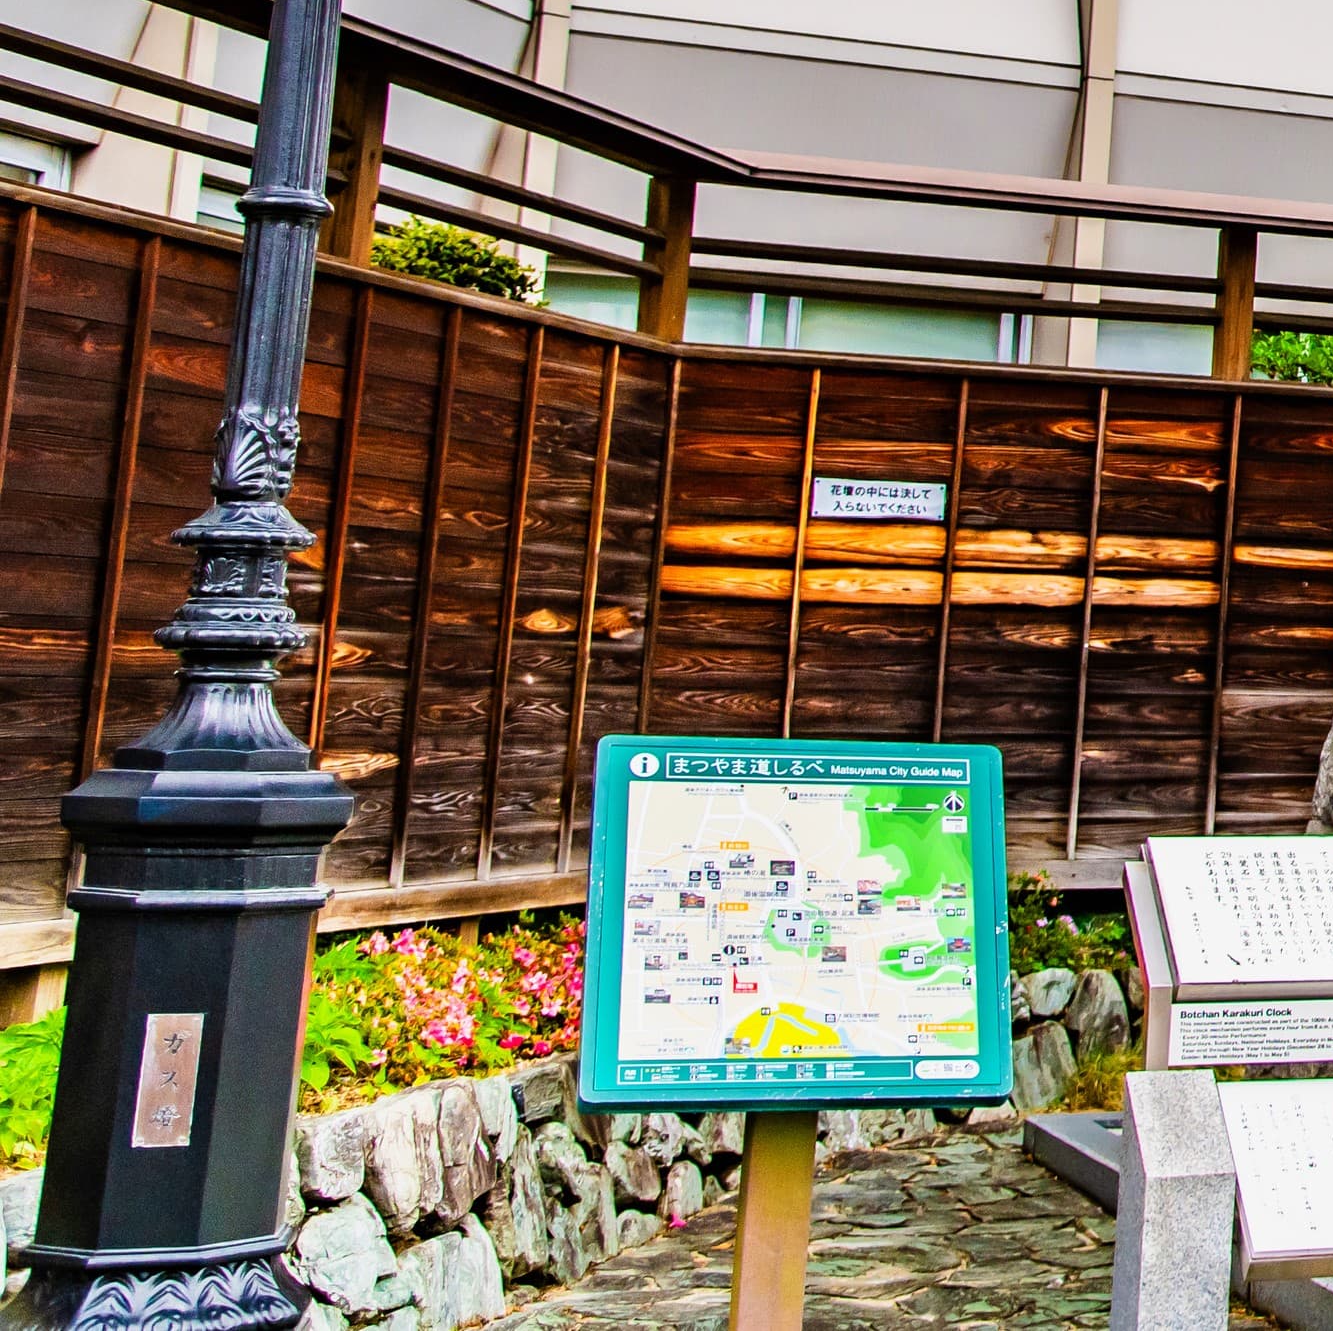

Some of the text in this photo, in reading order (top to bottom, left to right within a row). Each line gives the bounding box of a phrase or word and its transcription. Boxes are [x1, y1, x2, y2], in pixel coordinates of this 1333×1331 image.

[830, 485, 932, 499] 花壇の中には決して
[833, 501, 927, 515] 入らないでください
[672, 757, 963, 779] まつやま道しるべ Matsuyama City Guide Map
[1180, 1008, 1292, 1019] Botchan Karakuri Clock
